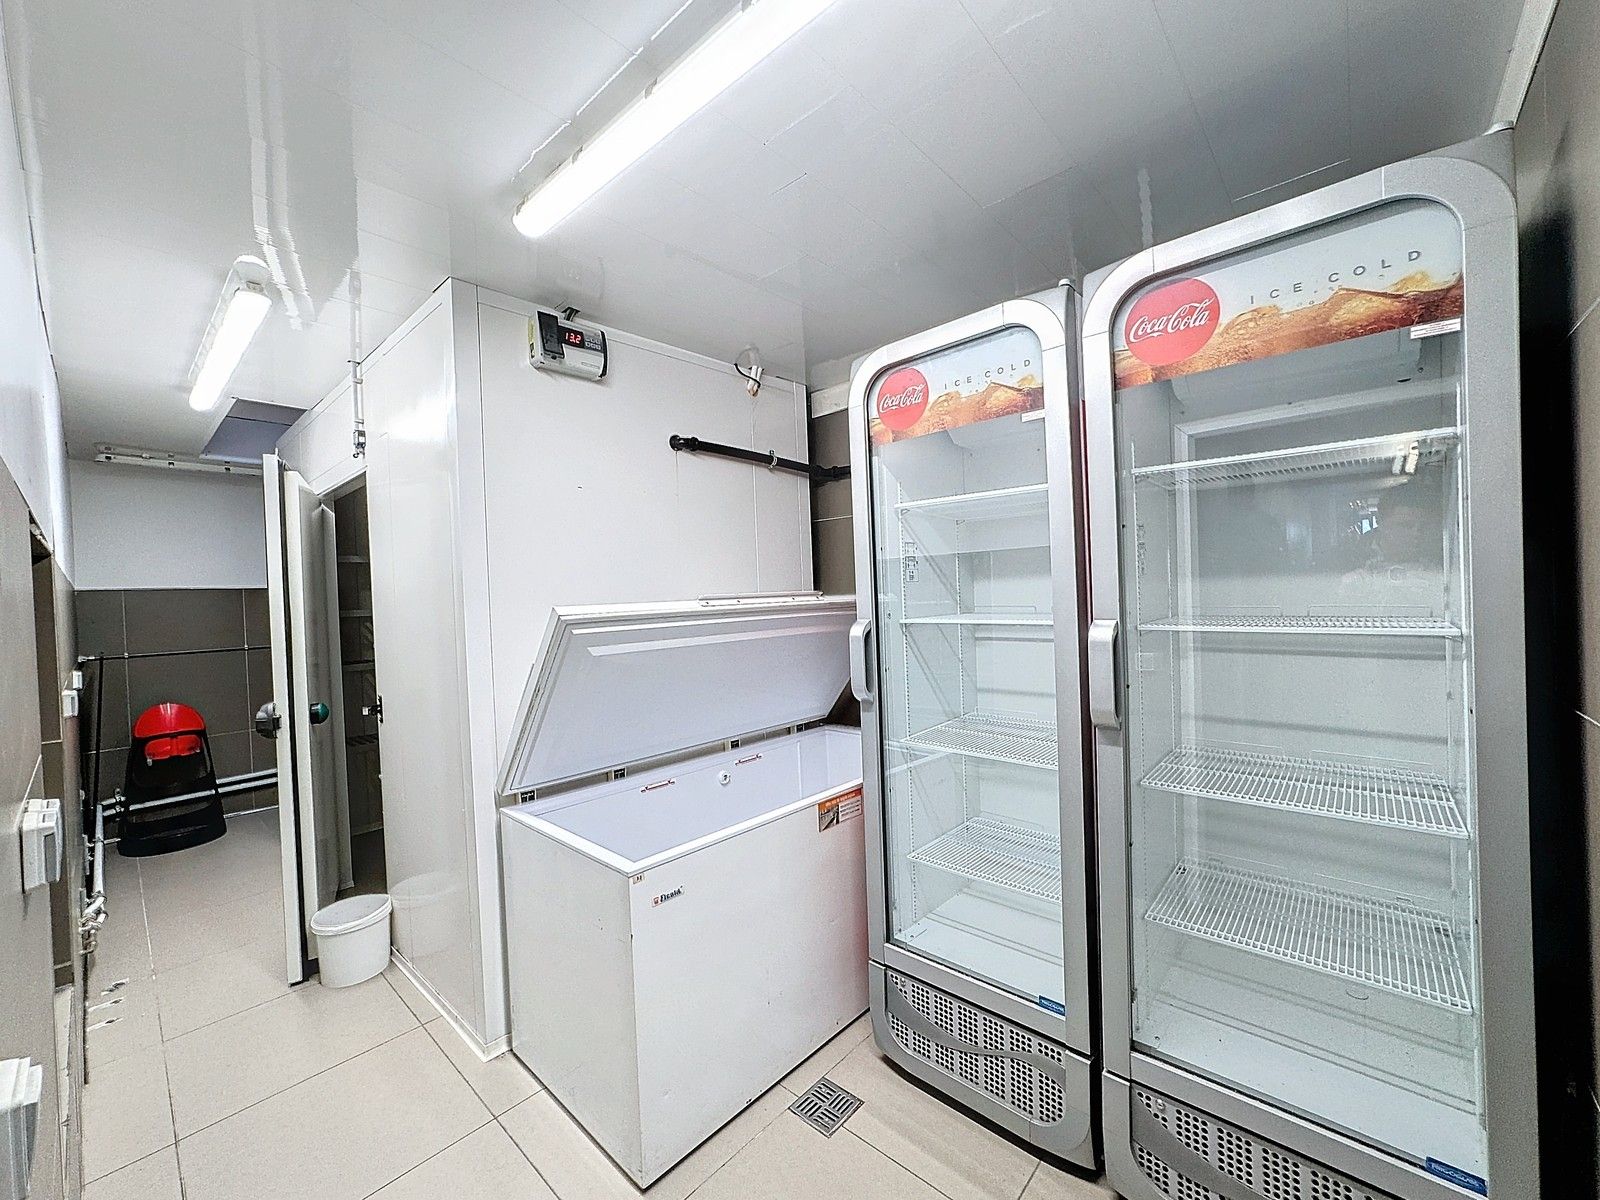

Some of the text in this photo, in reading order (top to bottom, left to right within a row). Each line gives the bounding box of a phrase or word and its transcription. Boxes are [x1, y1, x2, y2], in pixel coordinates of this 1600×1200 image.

[1249, 249, 1423, 305] ICE COLD
[1130, 298, 1215, 341] Coca-Cola
[944, 359, 1031, 390] ICE COLD
[879, 382, 926, 413] Coca-Cola
